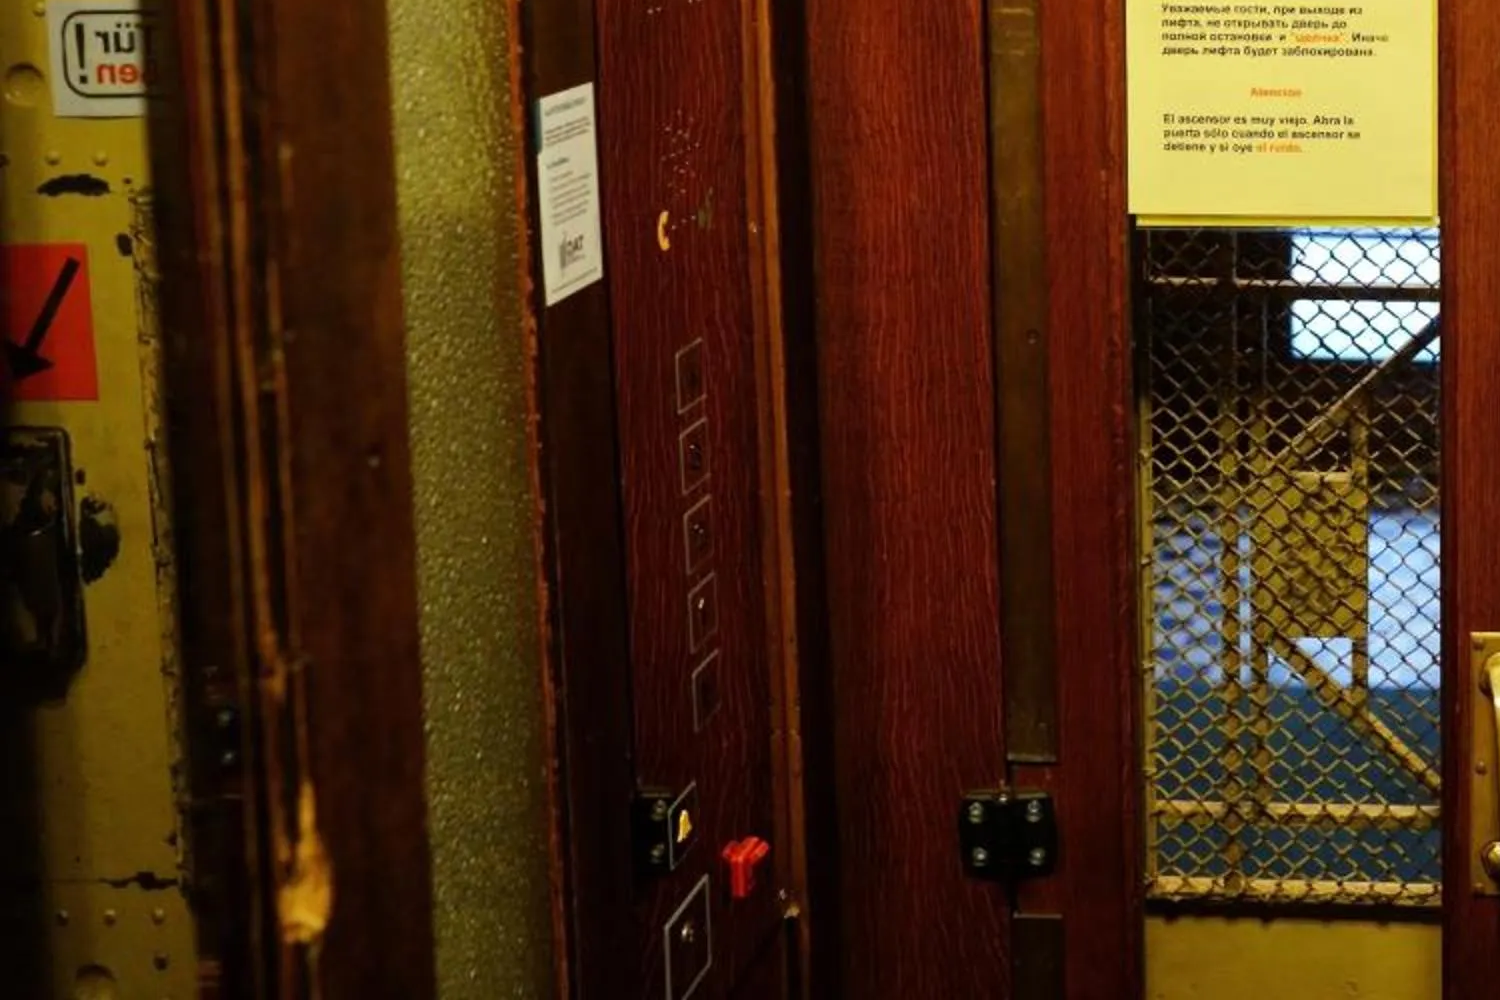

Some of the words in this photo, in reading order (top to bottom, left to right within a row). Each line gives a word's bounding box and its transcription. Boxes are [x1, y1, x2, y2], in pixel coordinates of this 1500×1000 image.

[1161, 3, 1231, 14] Уважаемые
[1233, 5, 1271, 15] гости,
[1273, 5, 1296, 16] при
[1299, 6, 1345, 15] выходе
[1349, 6, 1363, 15] из
[1206, 19, 1221, 28] не
[1223, 18, 1289, 30] открывать
[1291, 20, 1329, 31] дверь
[1331, 20, 1348, 31] до
[1161, 32, 1207, 41] полной
[1209, 32, 1273, 42] остановки
[1351, 31, 1389, 42] Иначе
[1161, 47, 1199, 58] дверь
[1201, 46, 1241, 58] лифта
[1243, 46, 1279, 58] будет
[1163, 113, 1175, 125] El
[1178, 115, 1231, 125] ascensor
[1234, 116, 1248, 125] es
[1251, 116, 1276, 127] muy
[1313, 115, 1341, 126] Abra
[1343, 116, 1355, 126] la
[1163, 128, 1202, 140] puerta
[1203, 127, 1229, 139] sólo
[1231, 128, 1275, 139] cuando
[1277, 128, 1289, 139] el
[1291, 130, 1345, 140] ascensor
[1347, 131, 1362, 140] se
[1163, 141, 1206, 152] detiene
[1231, 143, 1253, 154] oye
